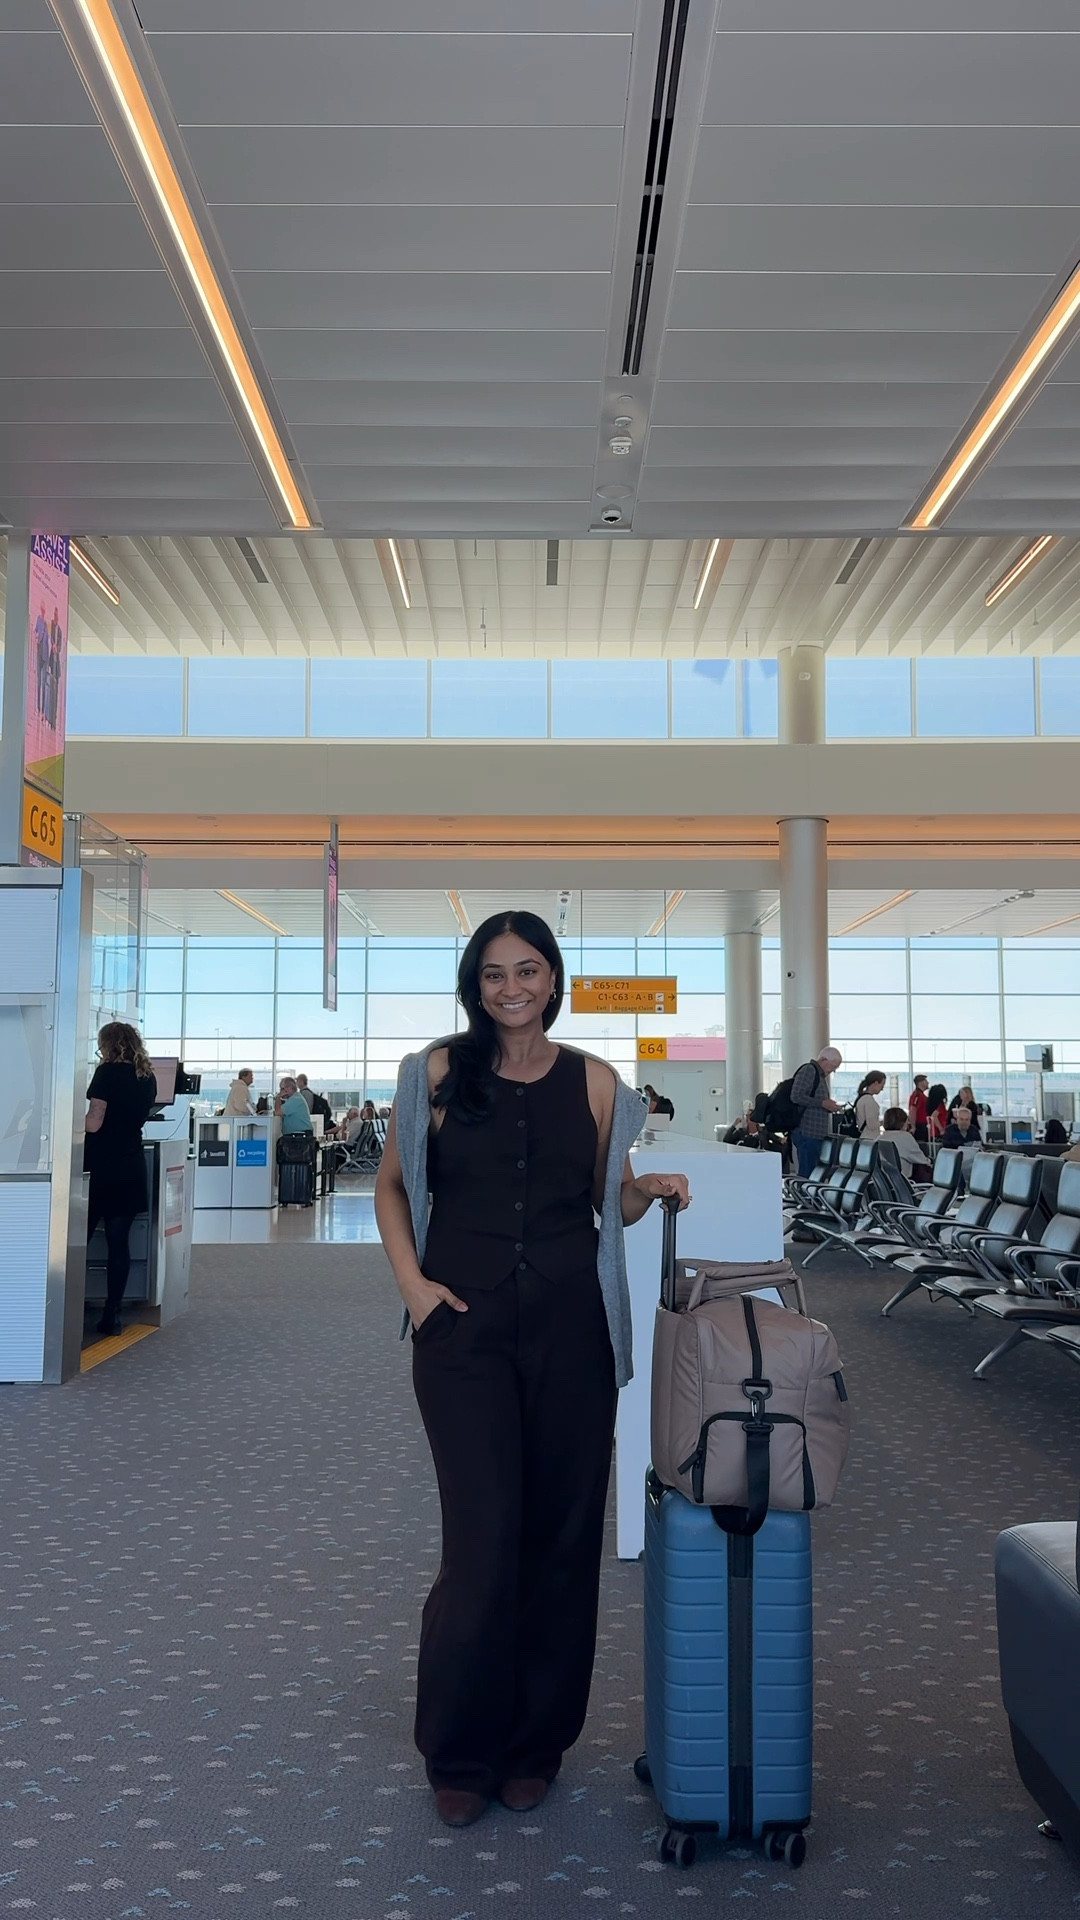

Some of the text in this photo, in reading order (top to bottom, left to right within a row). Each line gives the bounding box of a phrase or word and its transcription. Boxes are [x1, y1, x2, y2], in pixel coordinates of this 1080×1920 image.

[33, 535, 66, 573] ASSIST
[43, 535, 68, 564] AVEL
[30, 805, 56, 846] C65
[593, 981, 630, 990] C65-C71
[597, 993, 654, 1001] C1-C63 A B
[638, 1043, 665, 1054] C64
